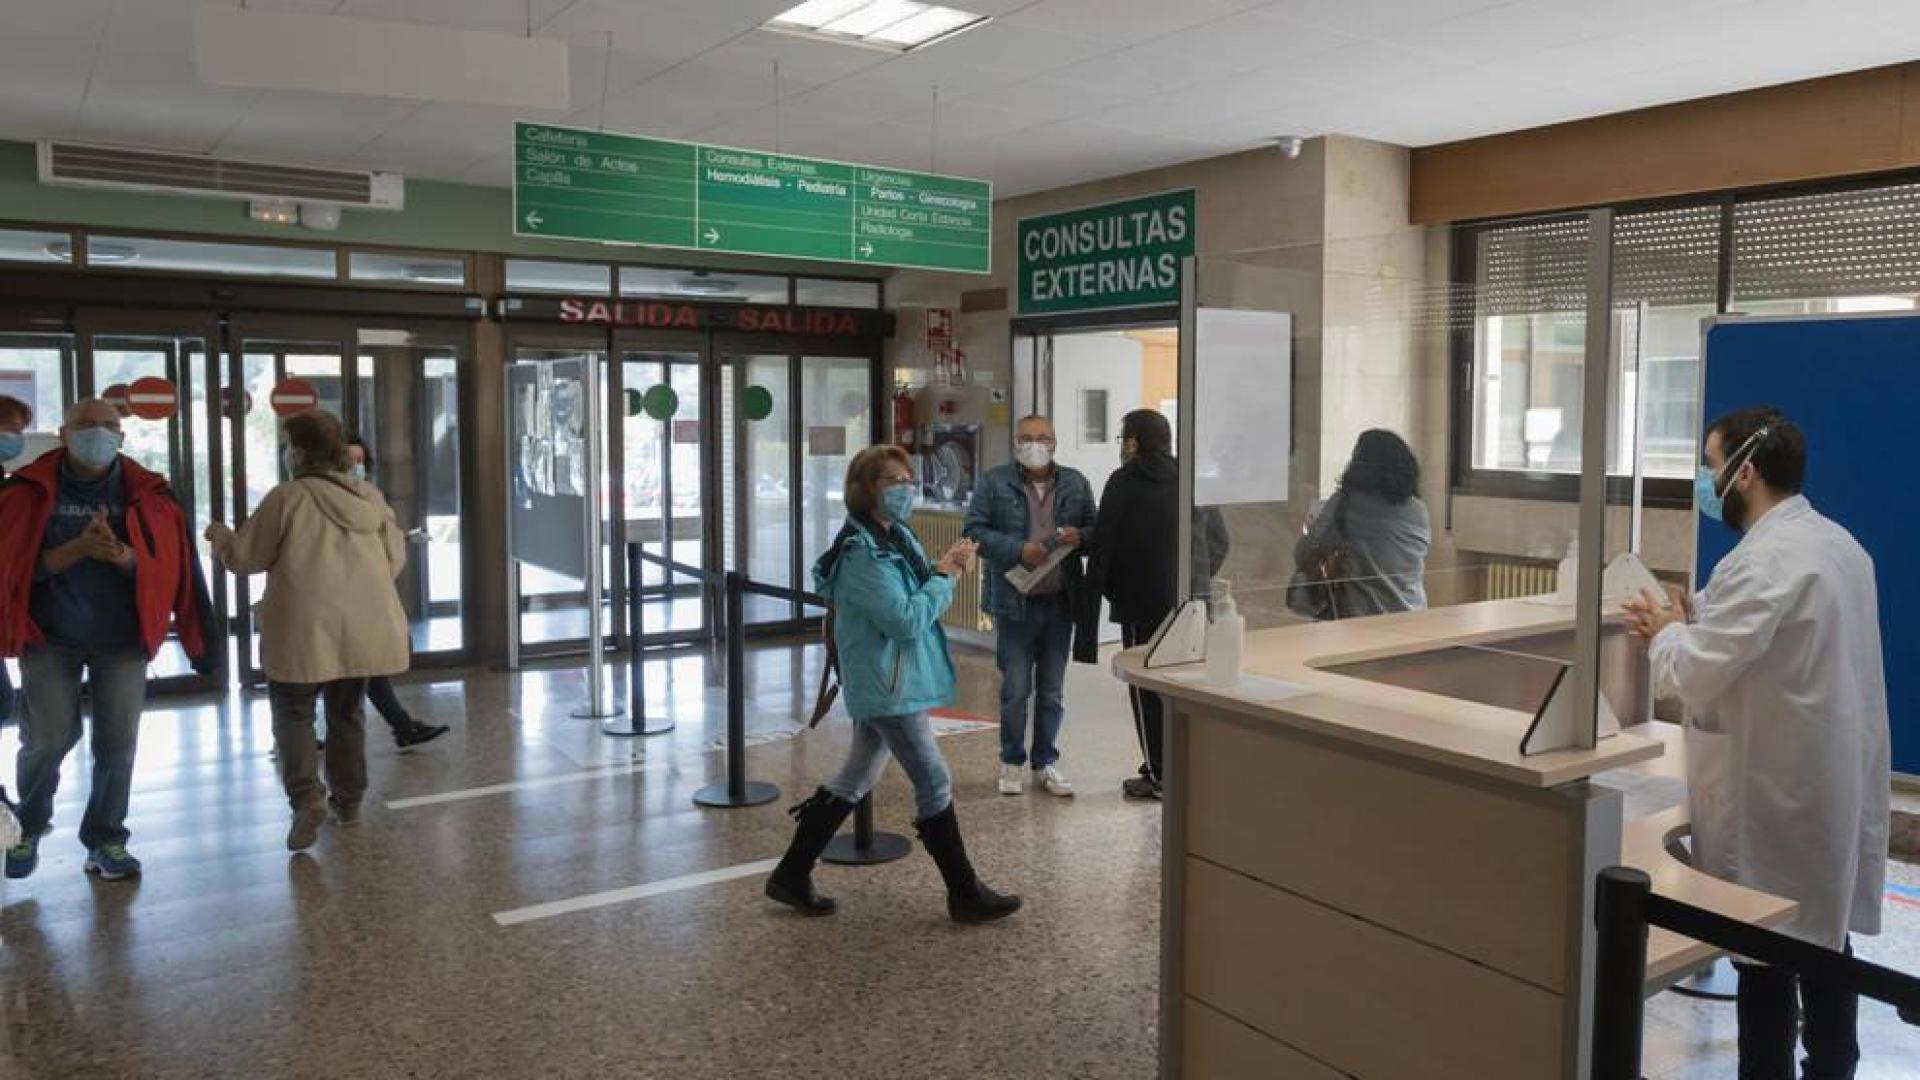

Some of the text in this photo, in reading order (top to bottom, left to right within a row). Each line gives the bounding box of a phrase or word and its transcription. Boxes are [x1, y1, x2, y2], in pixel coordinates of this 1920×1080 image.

[706, 150, 817, 175] Consultas Externas
[861, 169, 912, 187] Urgencias
[870, 187, 904, 201] Partos
[861, 205, 896, 218] Unidad
[1025, 205, 1187, 262] CONSULTAS
[1032, 252, 1177, 301] EXTERNAS
[559, 299, 857, 334] SALIDA SALIDA
